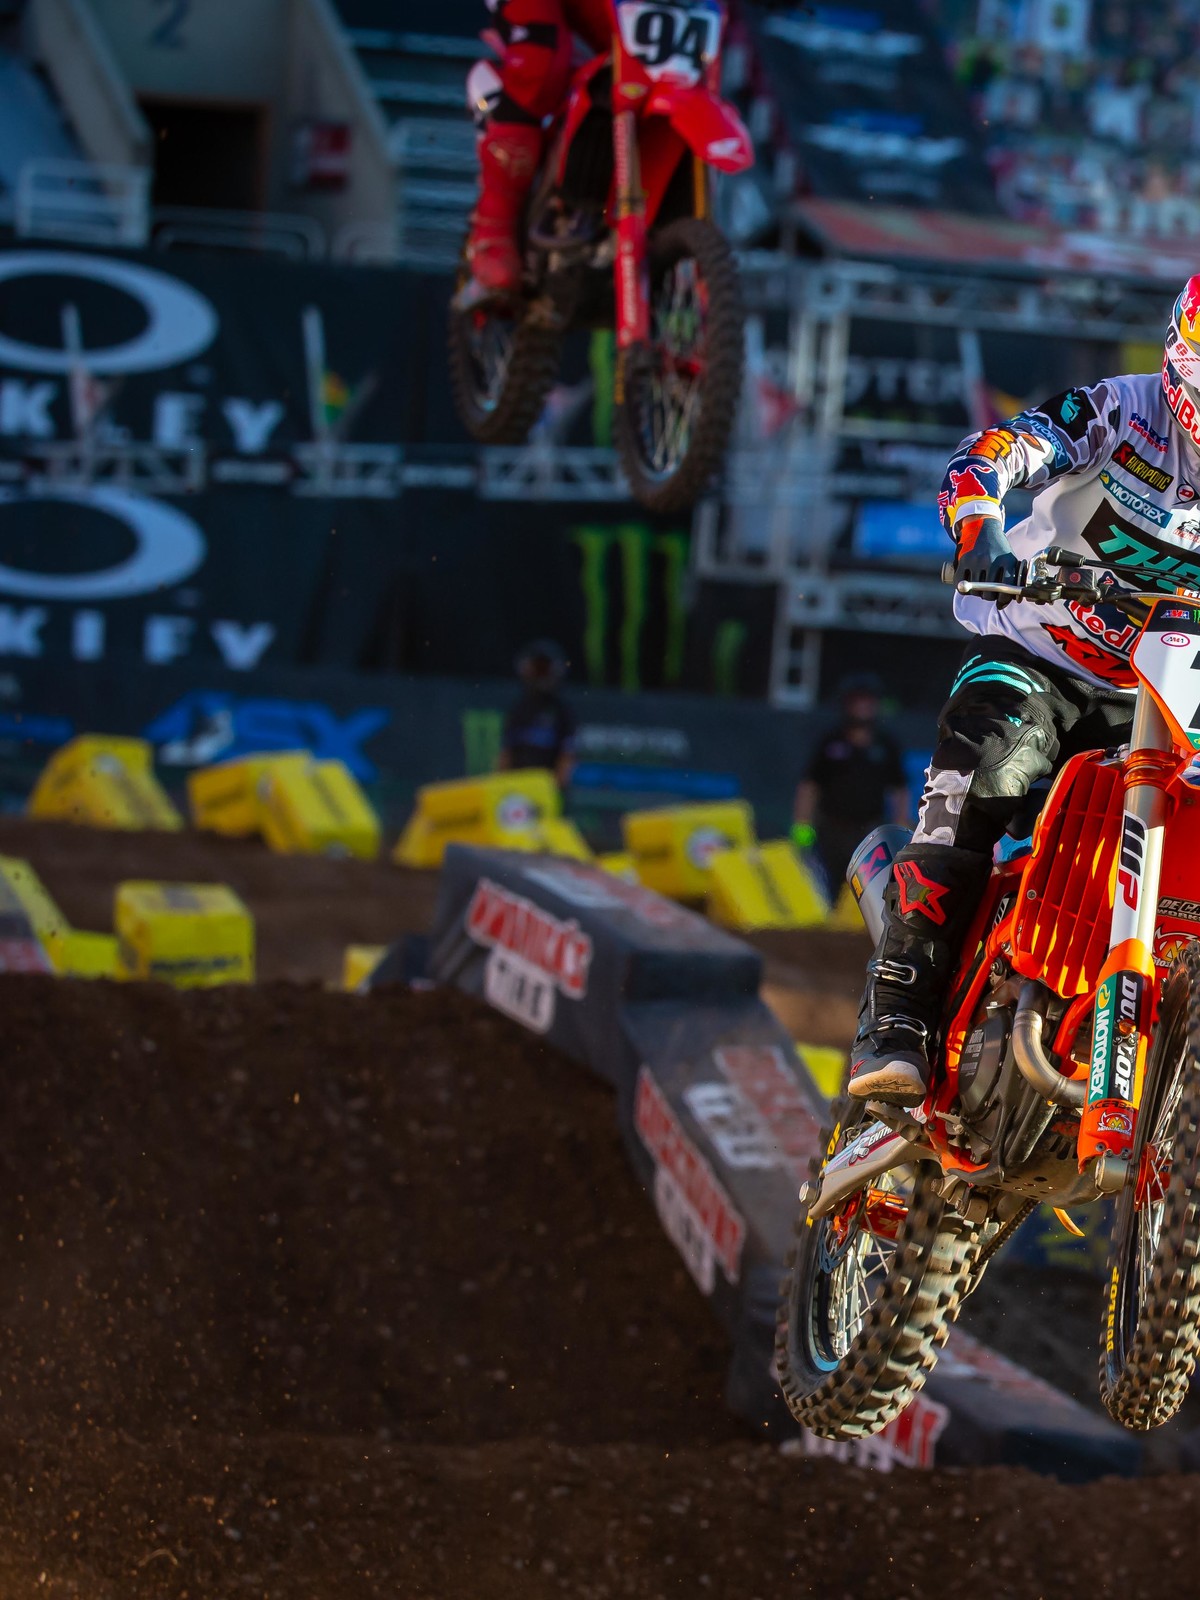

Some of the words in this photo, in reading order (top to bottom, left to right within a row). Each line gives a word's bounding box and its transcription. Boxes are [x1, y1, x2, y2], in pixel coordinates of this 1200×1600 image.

[634, 10, 711, 69] 94
[1109, 481, 1165, 524] MOTOREX
[1089, 1010, 1110, 1100] MOTOREX
[1115, 976, 1137, 1100] DULOP
[1106, 1266, 1119, 1354] DUNLOP
